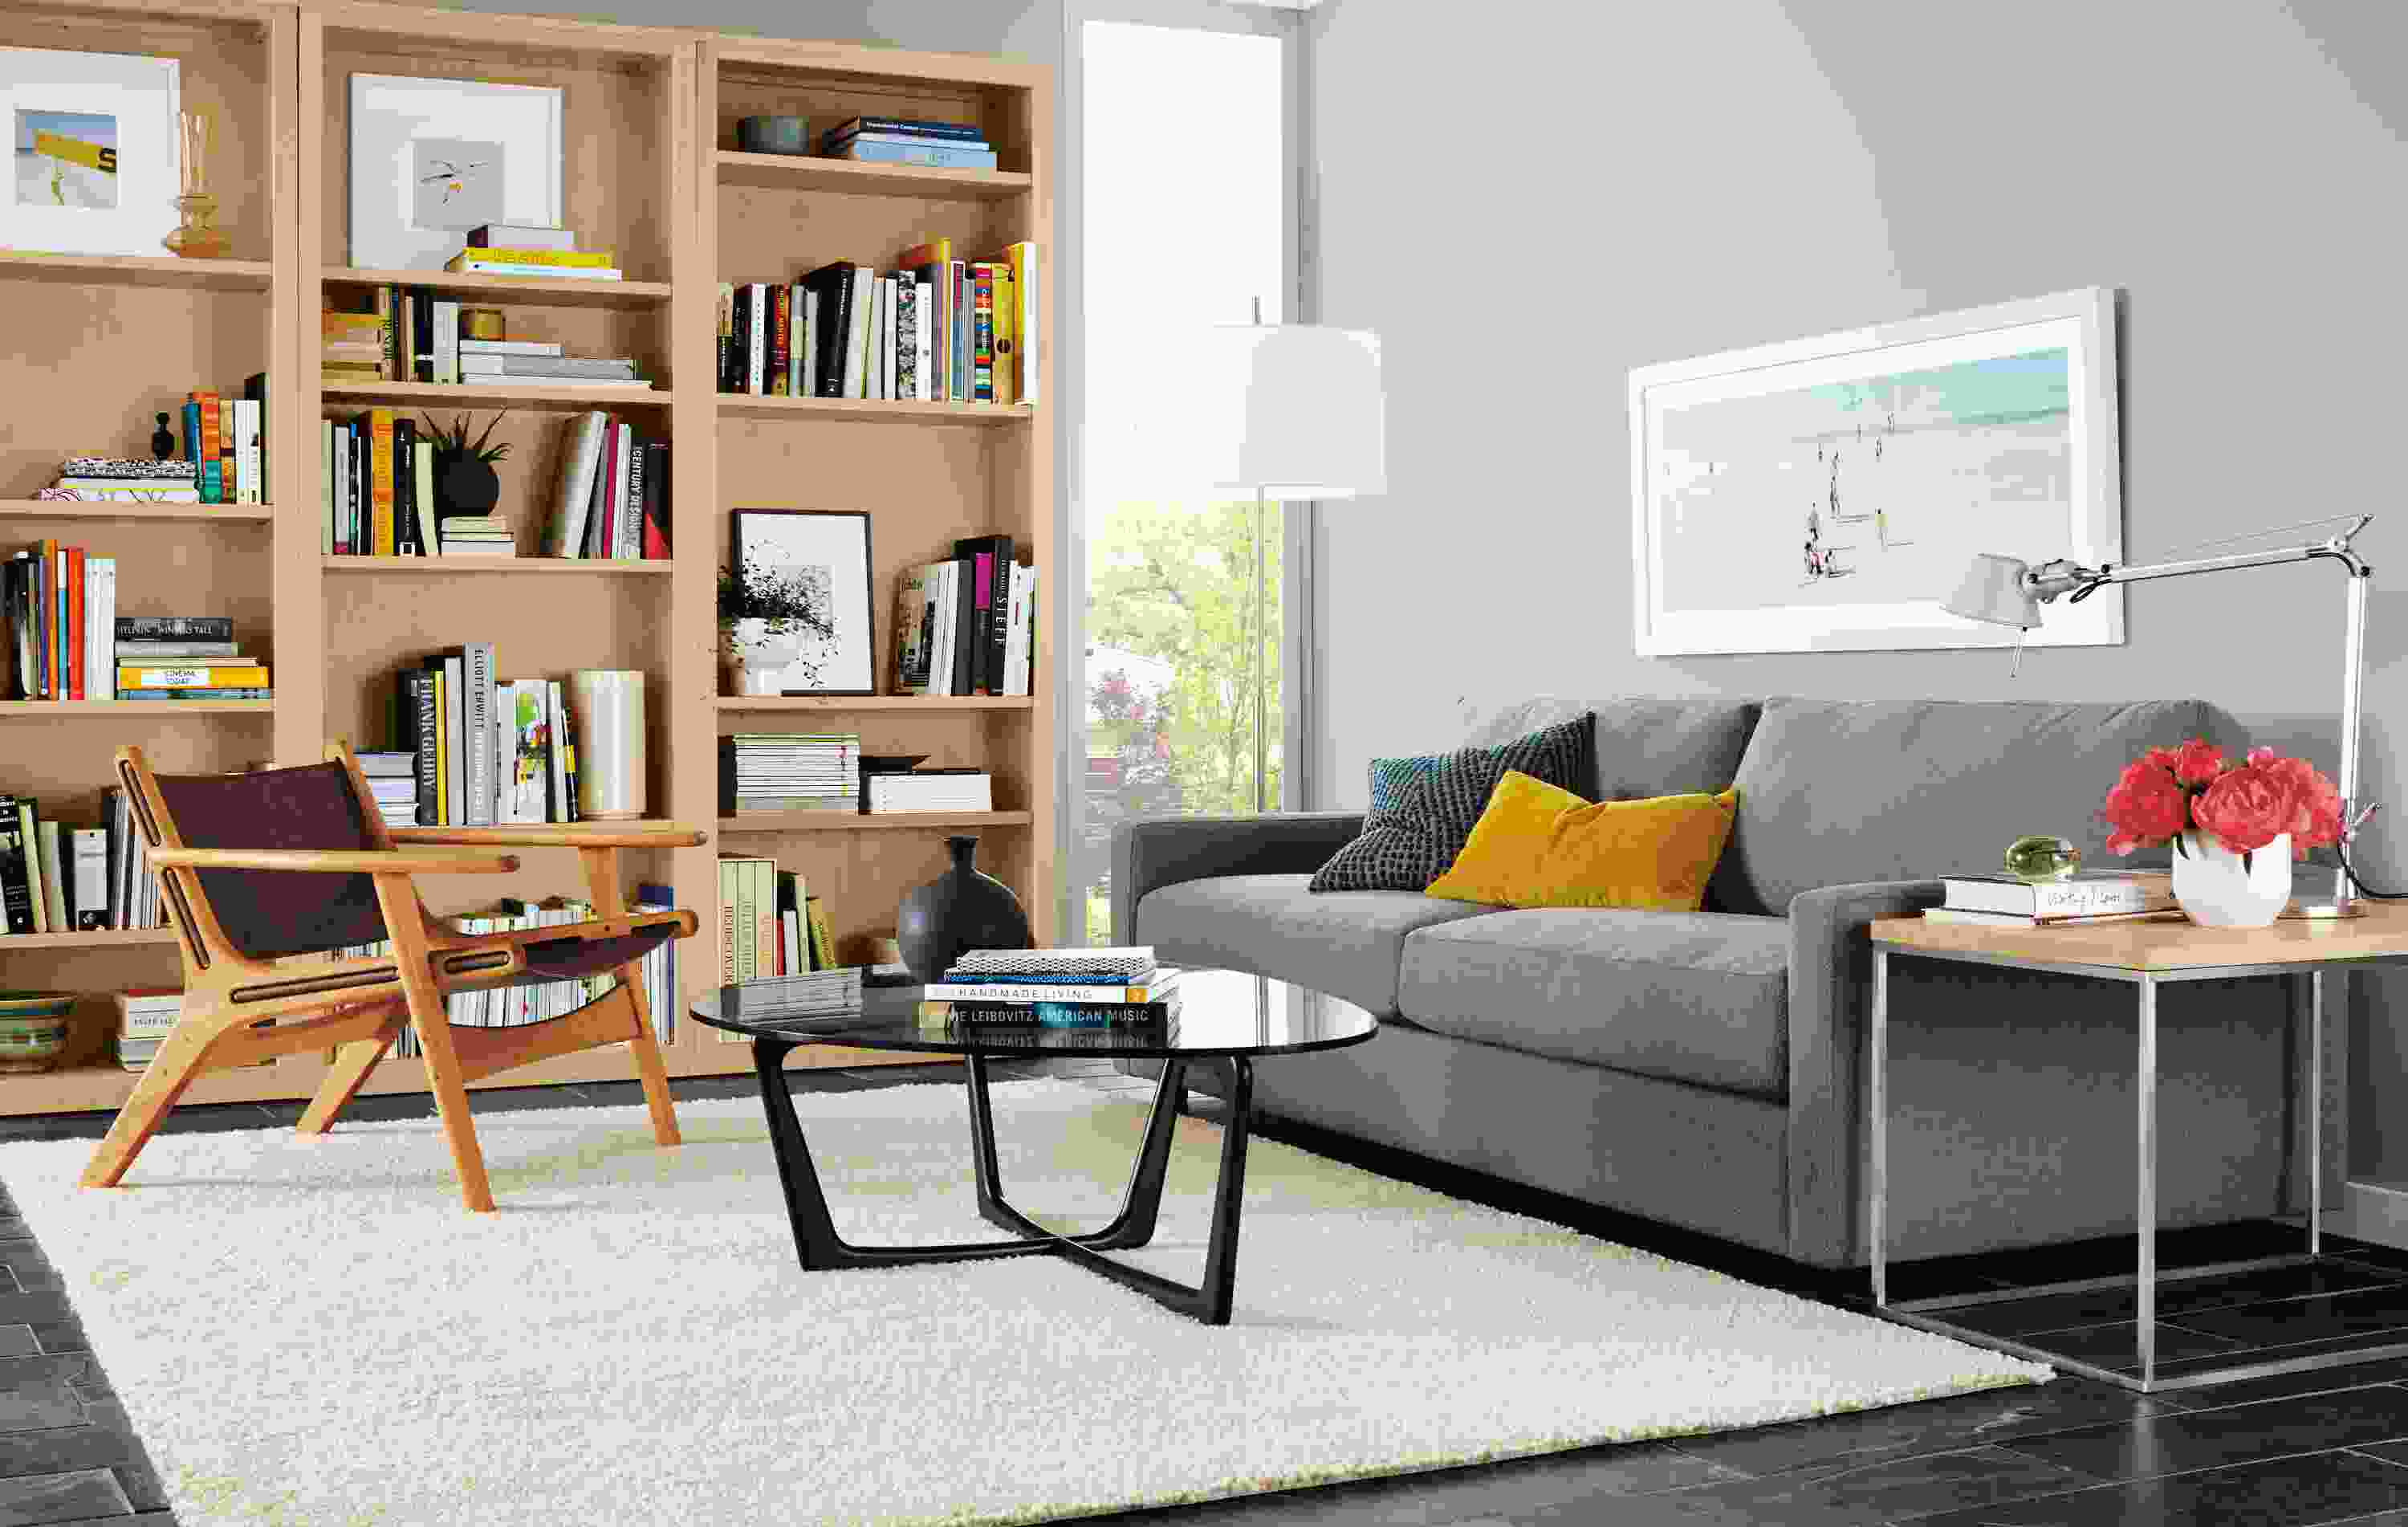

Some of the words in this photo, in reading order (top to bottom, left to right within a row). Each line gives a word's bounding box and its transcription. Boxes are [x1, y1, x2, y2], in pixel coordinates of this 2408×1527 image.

[630, 450, 643, 493] CENTURY
[474, 649, 484, 688] ELLIOTT
[958, 988, 1038, 1000] HANDMADE
[1043, 988, 1093, 1000] LIVING
[971, 1009, 1035, 1022] LEIBOVITZ
[1039, 1009, 1104, 1022] AMERICAN
[1109, 1008, 1149, 1022] MUSIC
